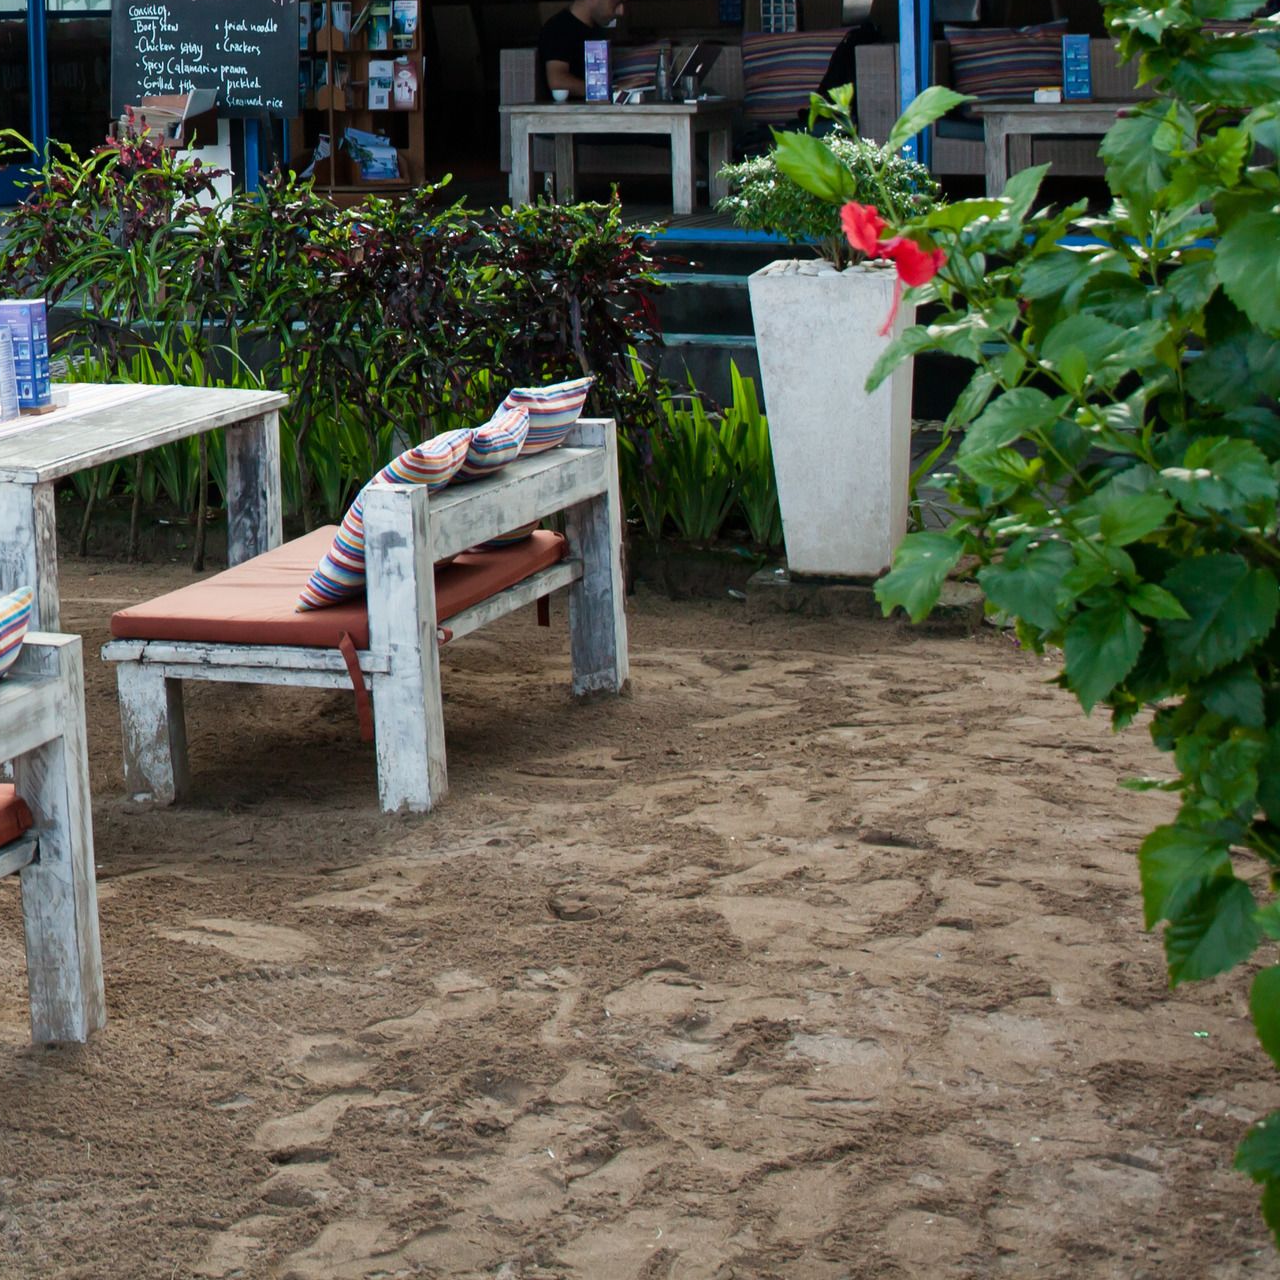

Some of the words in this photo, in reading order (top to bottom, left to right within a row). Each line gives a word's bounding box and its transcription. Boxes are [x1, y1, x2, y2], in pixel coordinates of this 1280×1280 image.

[251, 18, 278, 32] noodle
[138, 36, 175, 53] Chicken
[181, 42, 203, 61] satay
[223, 37, 260, 55] Crackers
[143, 55, 164, 75] Spicy
[167, 58, 210, 74] Calamari
[221, 65, 247, 81] prawn
[143, 76, 174, 90] Grilled
[227, 77, 261, 94] pickled
[266, 97, 283, 108] rice
